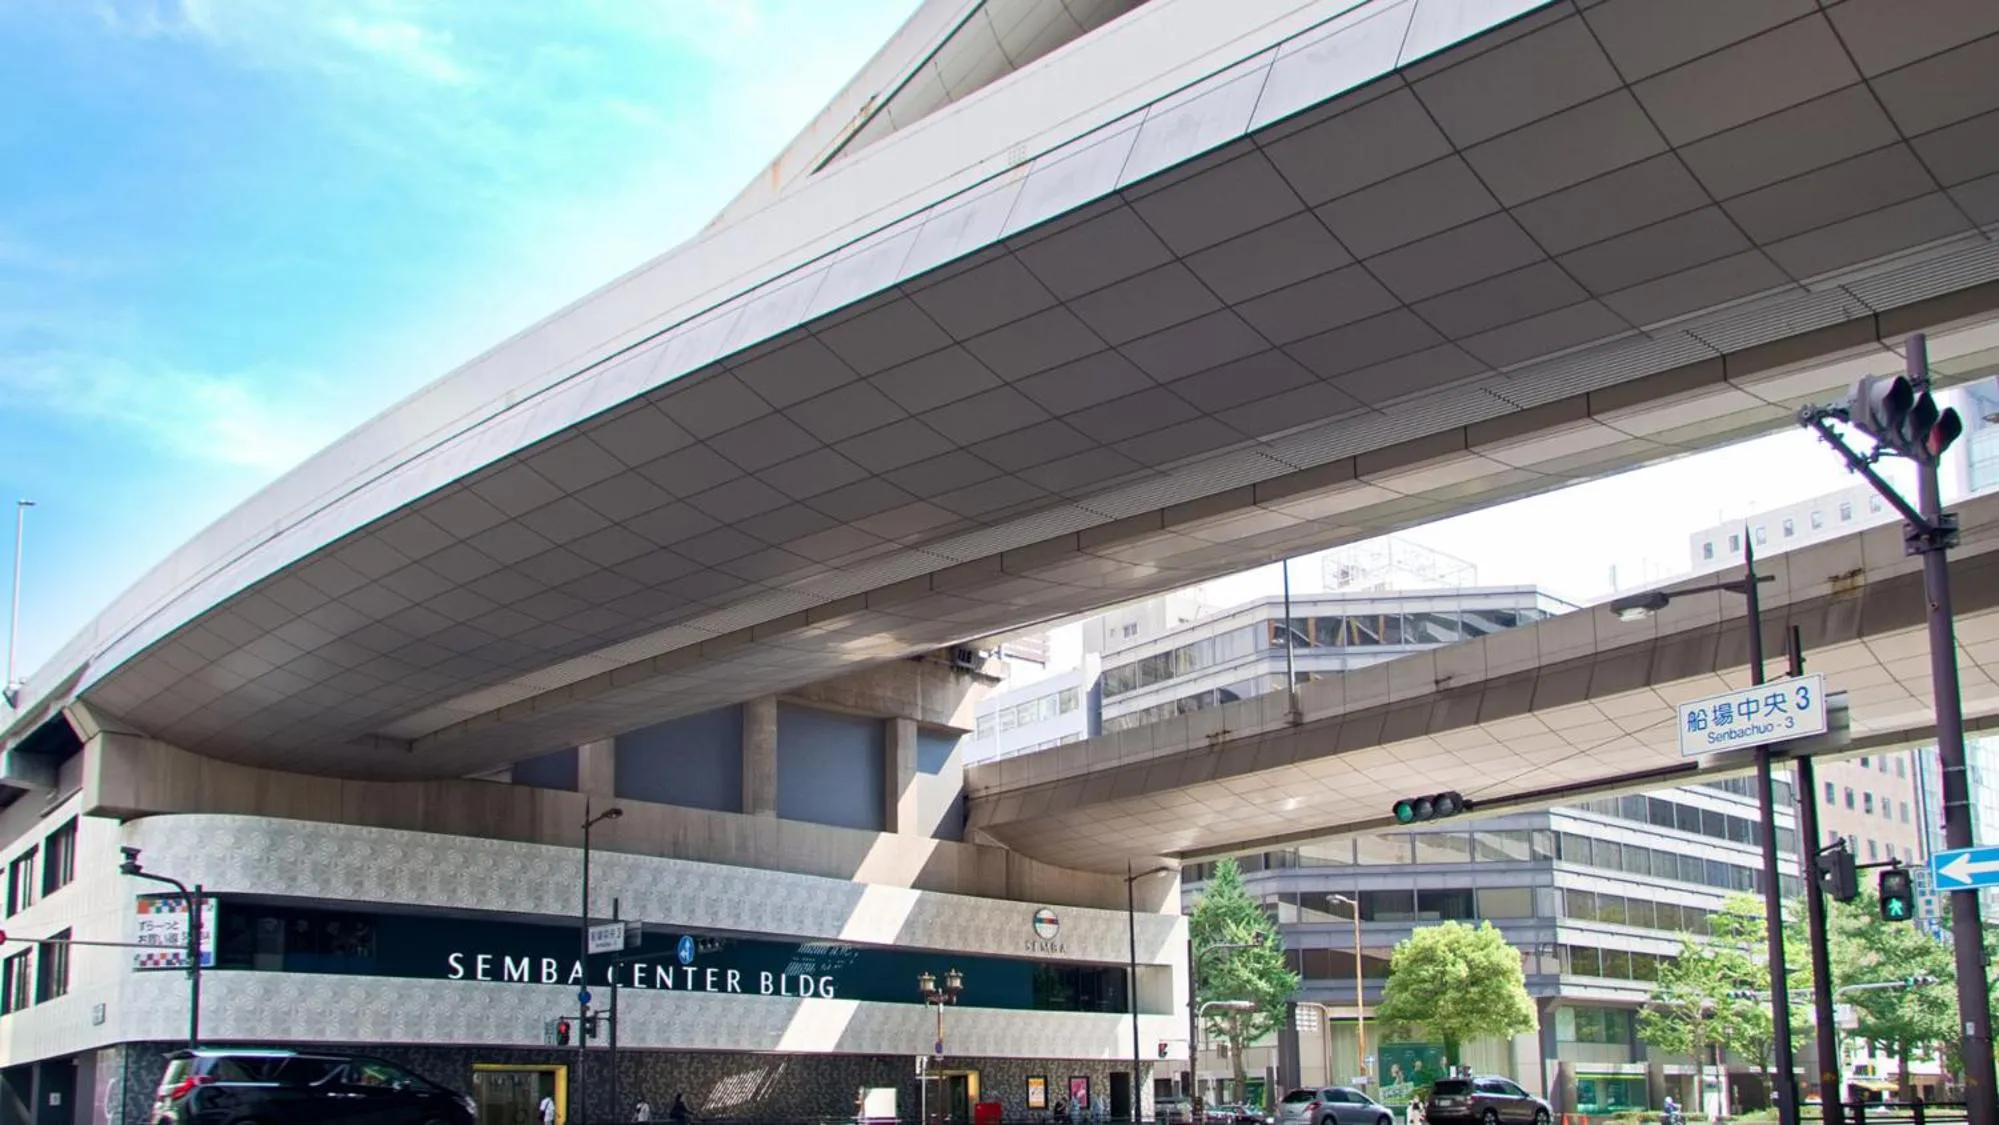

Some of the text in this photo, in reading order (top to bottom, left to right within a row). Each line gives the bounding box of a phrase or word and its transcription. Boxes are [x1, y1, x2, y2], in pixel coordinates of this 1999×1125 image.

[1707, 721, 1774, 744] Senbachuo
[448, 953, 585, 984] SEMBA
[760, 971, 834, 998] BLDG
